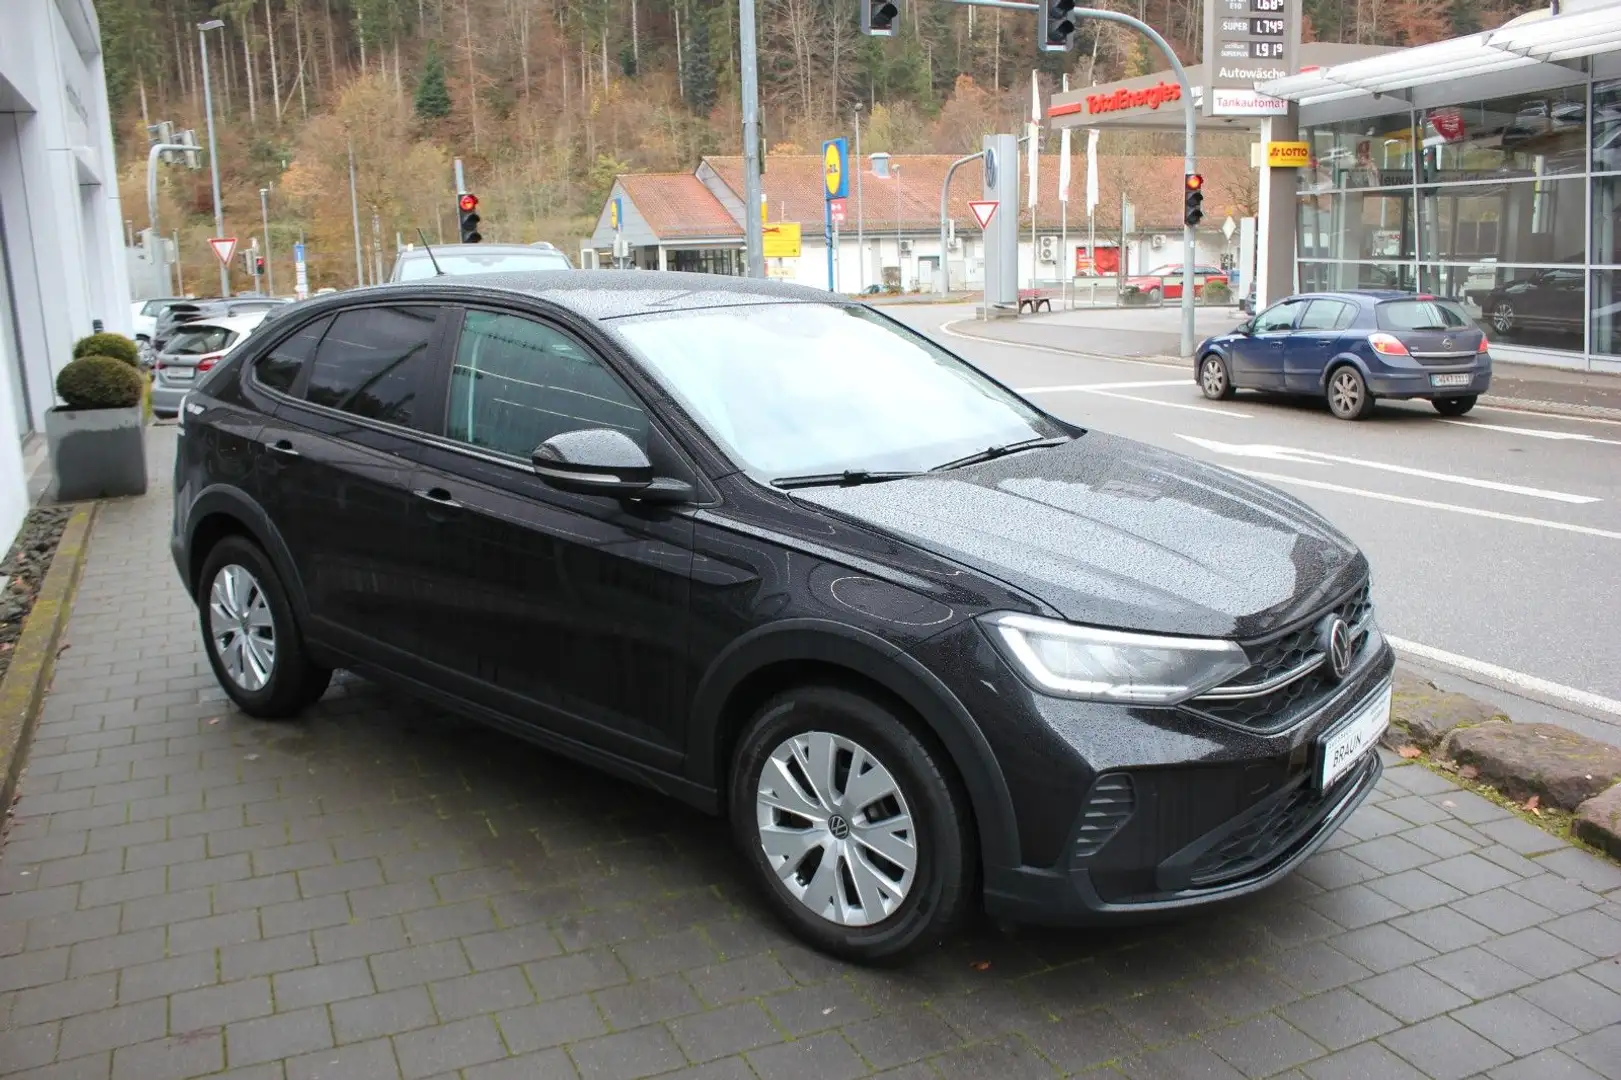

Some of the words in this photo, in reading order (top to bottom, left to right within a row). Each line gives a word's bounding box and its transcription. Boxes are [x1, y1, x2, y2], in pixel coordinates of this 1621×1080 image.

[1222, 21, 1248, 31] SUPER
[1218, 67, 1286, 79] Autowäsche
[1086, 82, 1181, 114] TotalEnergies
[1217, 97, 1285, 108] Tankautomat
[1281, 147, 1308, 157] LOTTO
[1333, 731, 1362, 768] BRAUN
